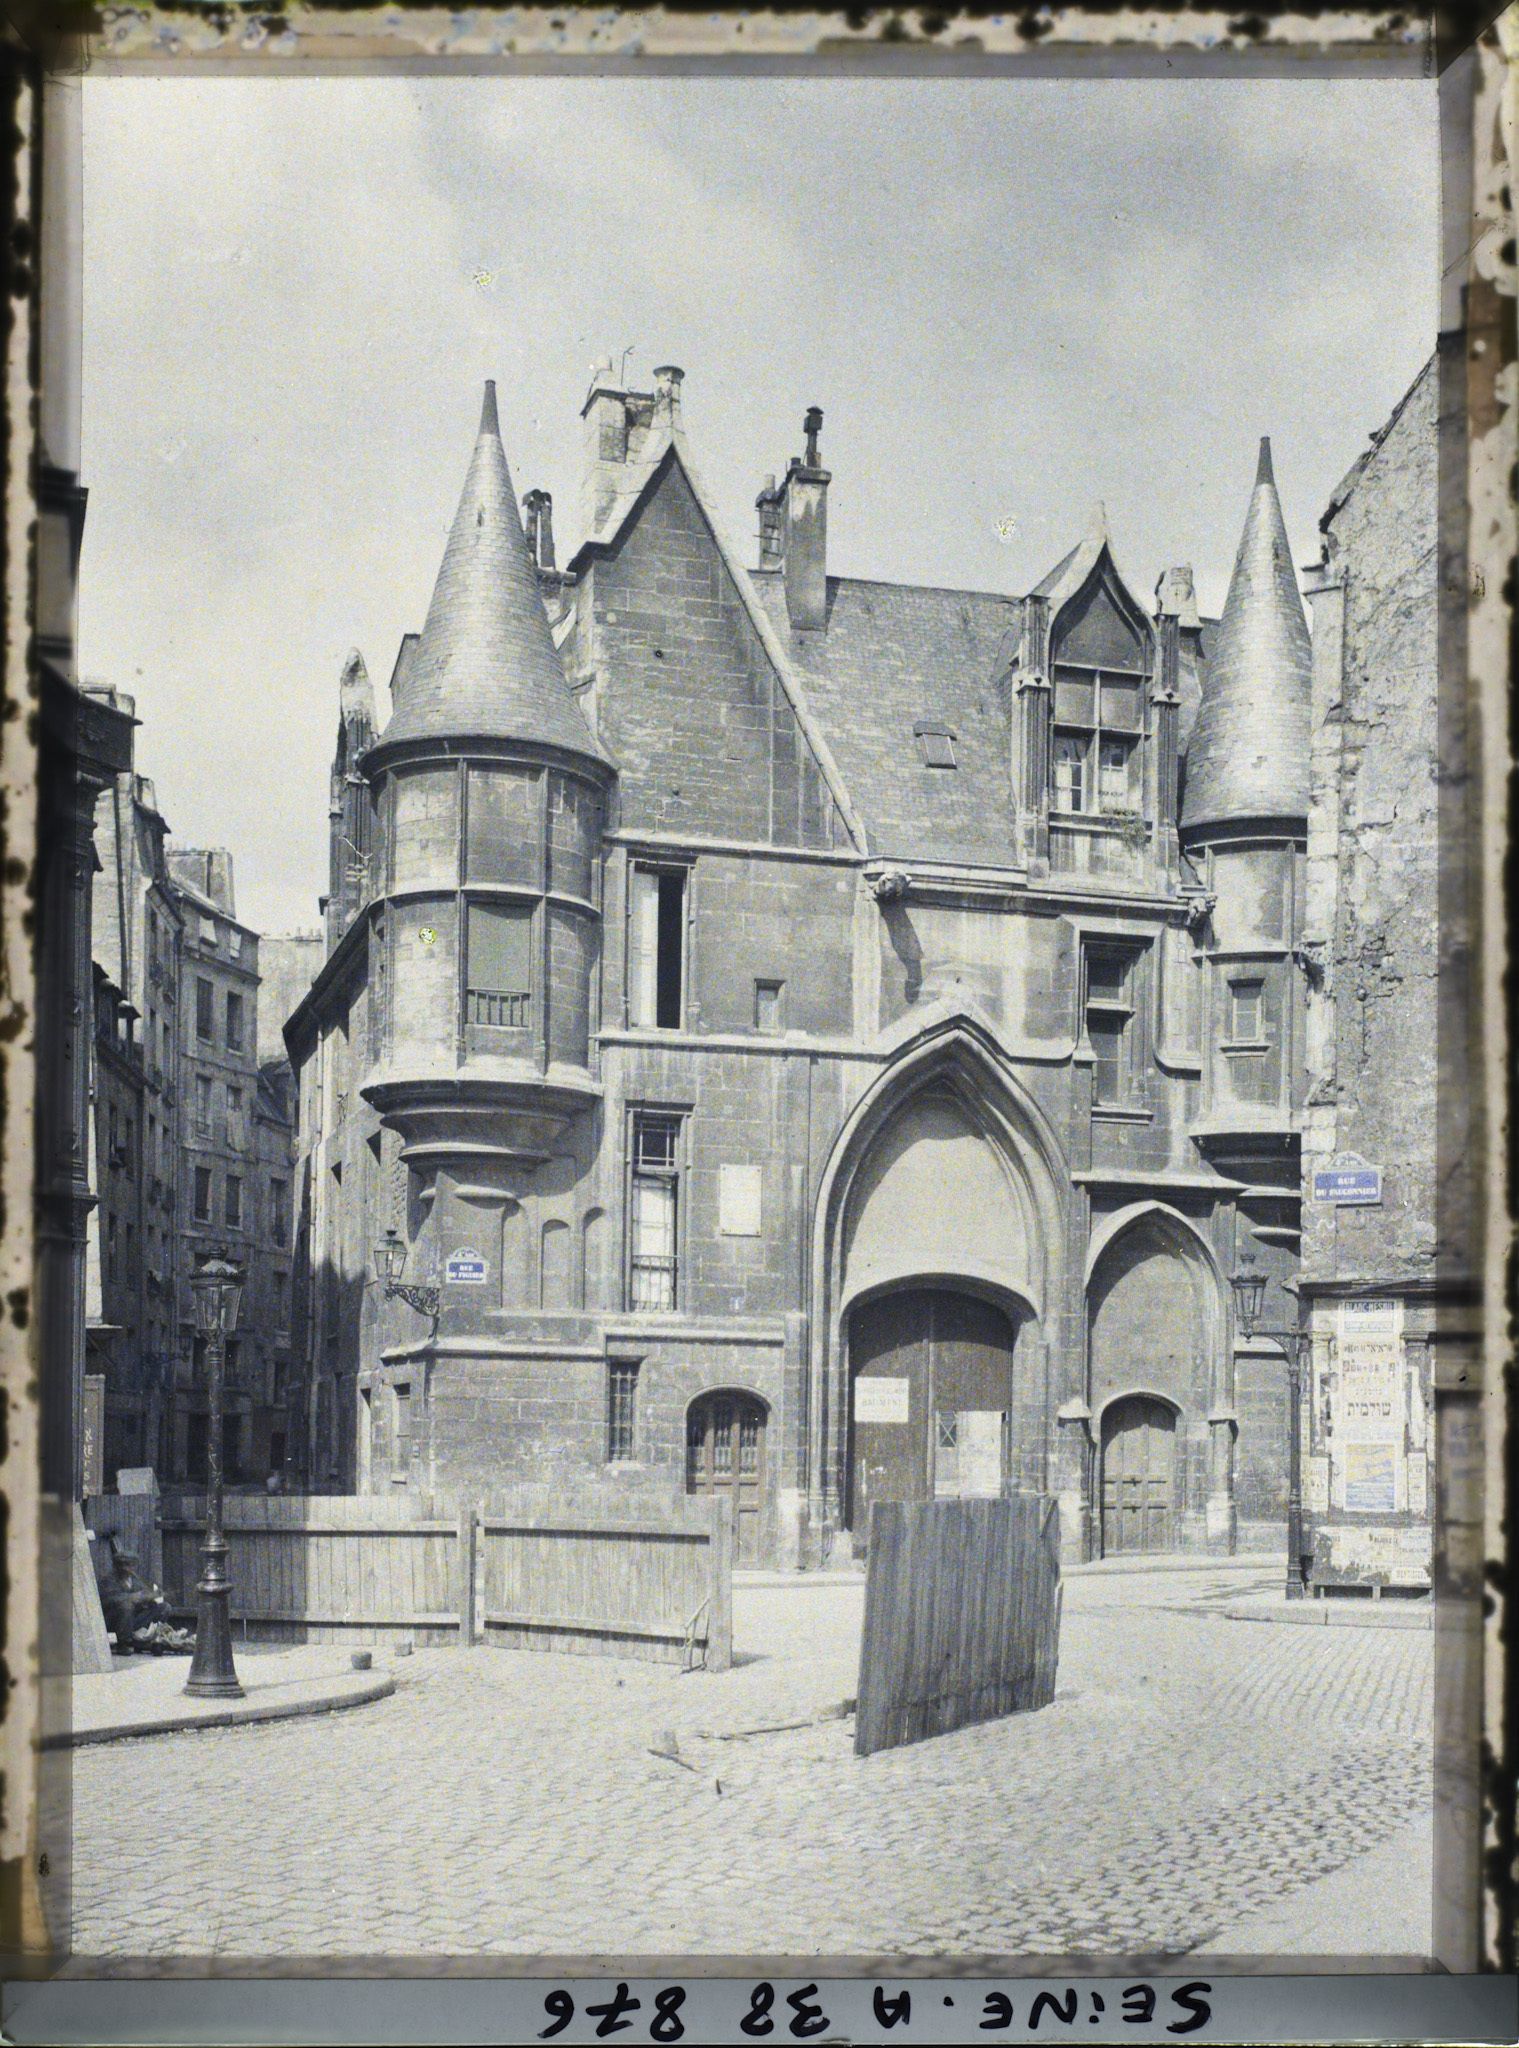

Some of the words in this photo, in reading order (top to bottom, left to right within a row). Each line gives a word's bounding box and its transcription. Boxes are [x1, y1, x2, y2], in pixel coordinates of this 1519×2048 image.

[1338, 1177, 1356, 1186] RUE
[1315, 1189, 1327, 1197] DU
[459, 1264, 474, 1272] RUE
[1347, 1402, 1391, 1417] שולמית
[537, 1983, 687, 2043] 876
[738, 1981, 831, 2038] 38
[872, 1986, 911, 2029] A
